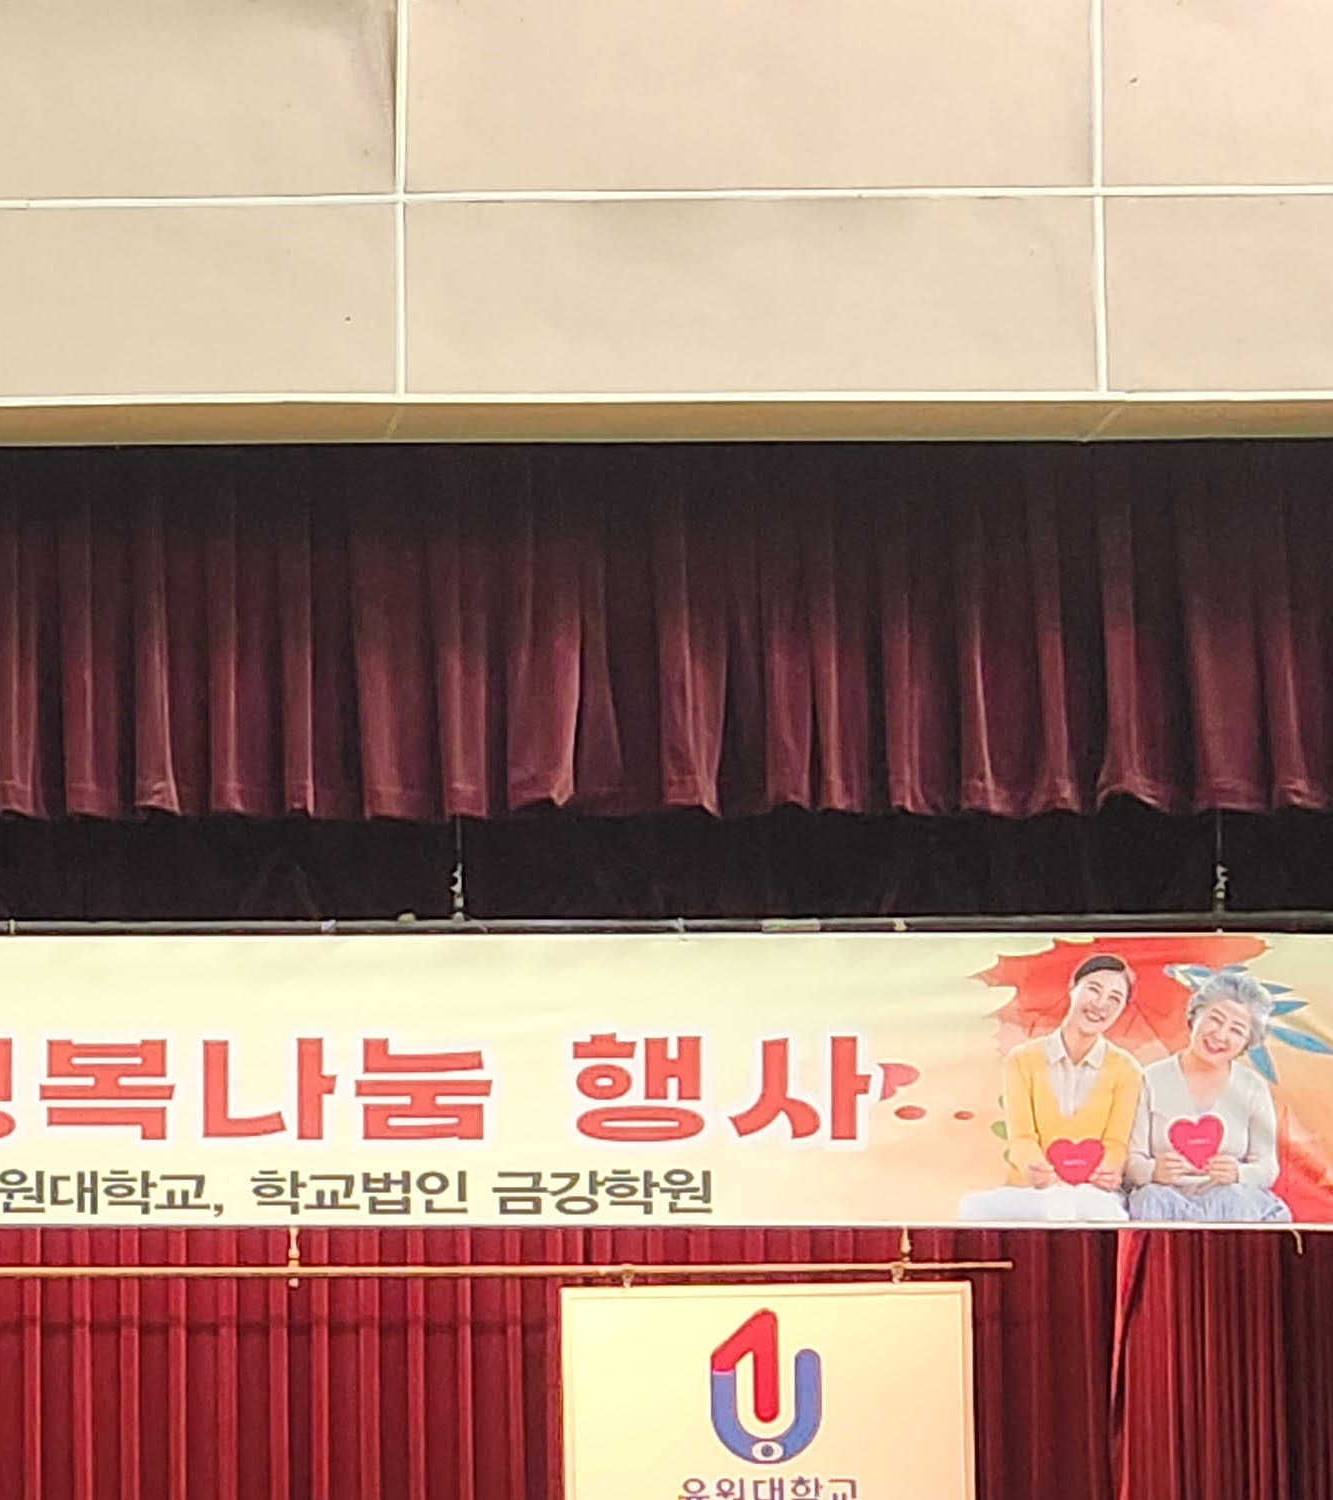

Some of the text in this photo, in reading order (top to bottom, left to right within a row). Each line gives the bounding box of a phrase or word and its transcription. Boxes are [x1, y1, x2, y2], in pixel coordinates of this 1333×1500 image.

[573, 1033, 871, 1142] 행사
[250, 1170, 468, 1215] 학교법인
[492, 1169, 713, 1215] 금강학원
